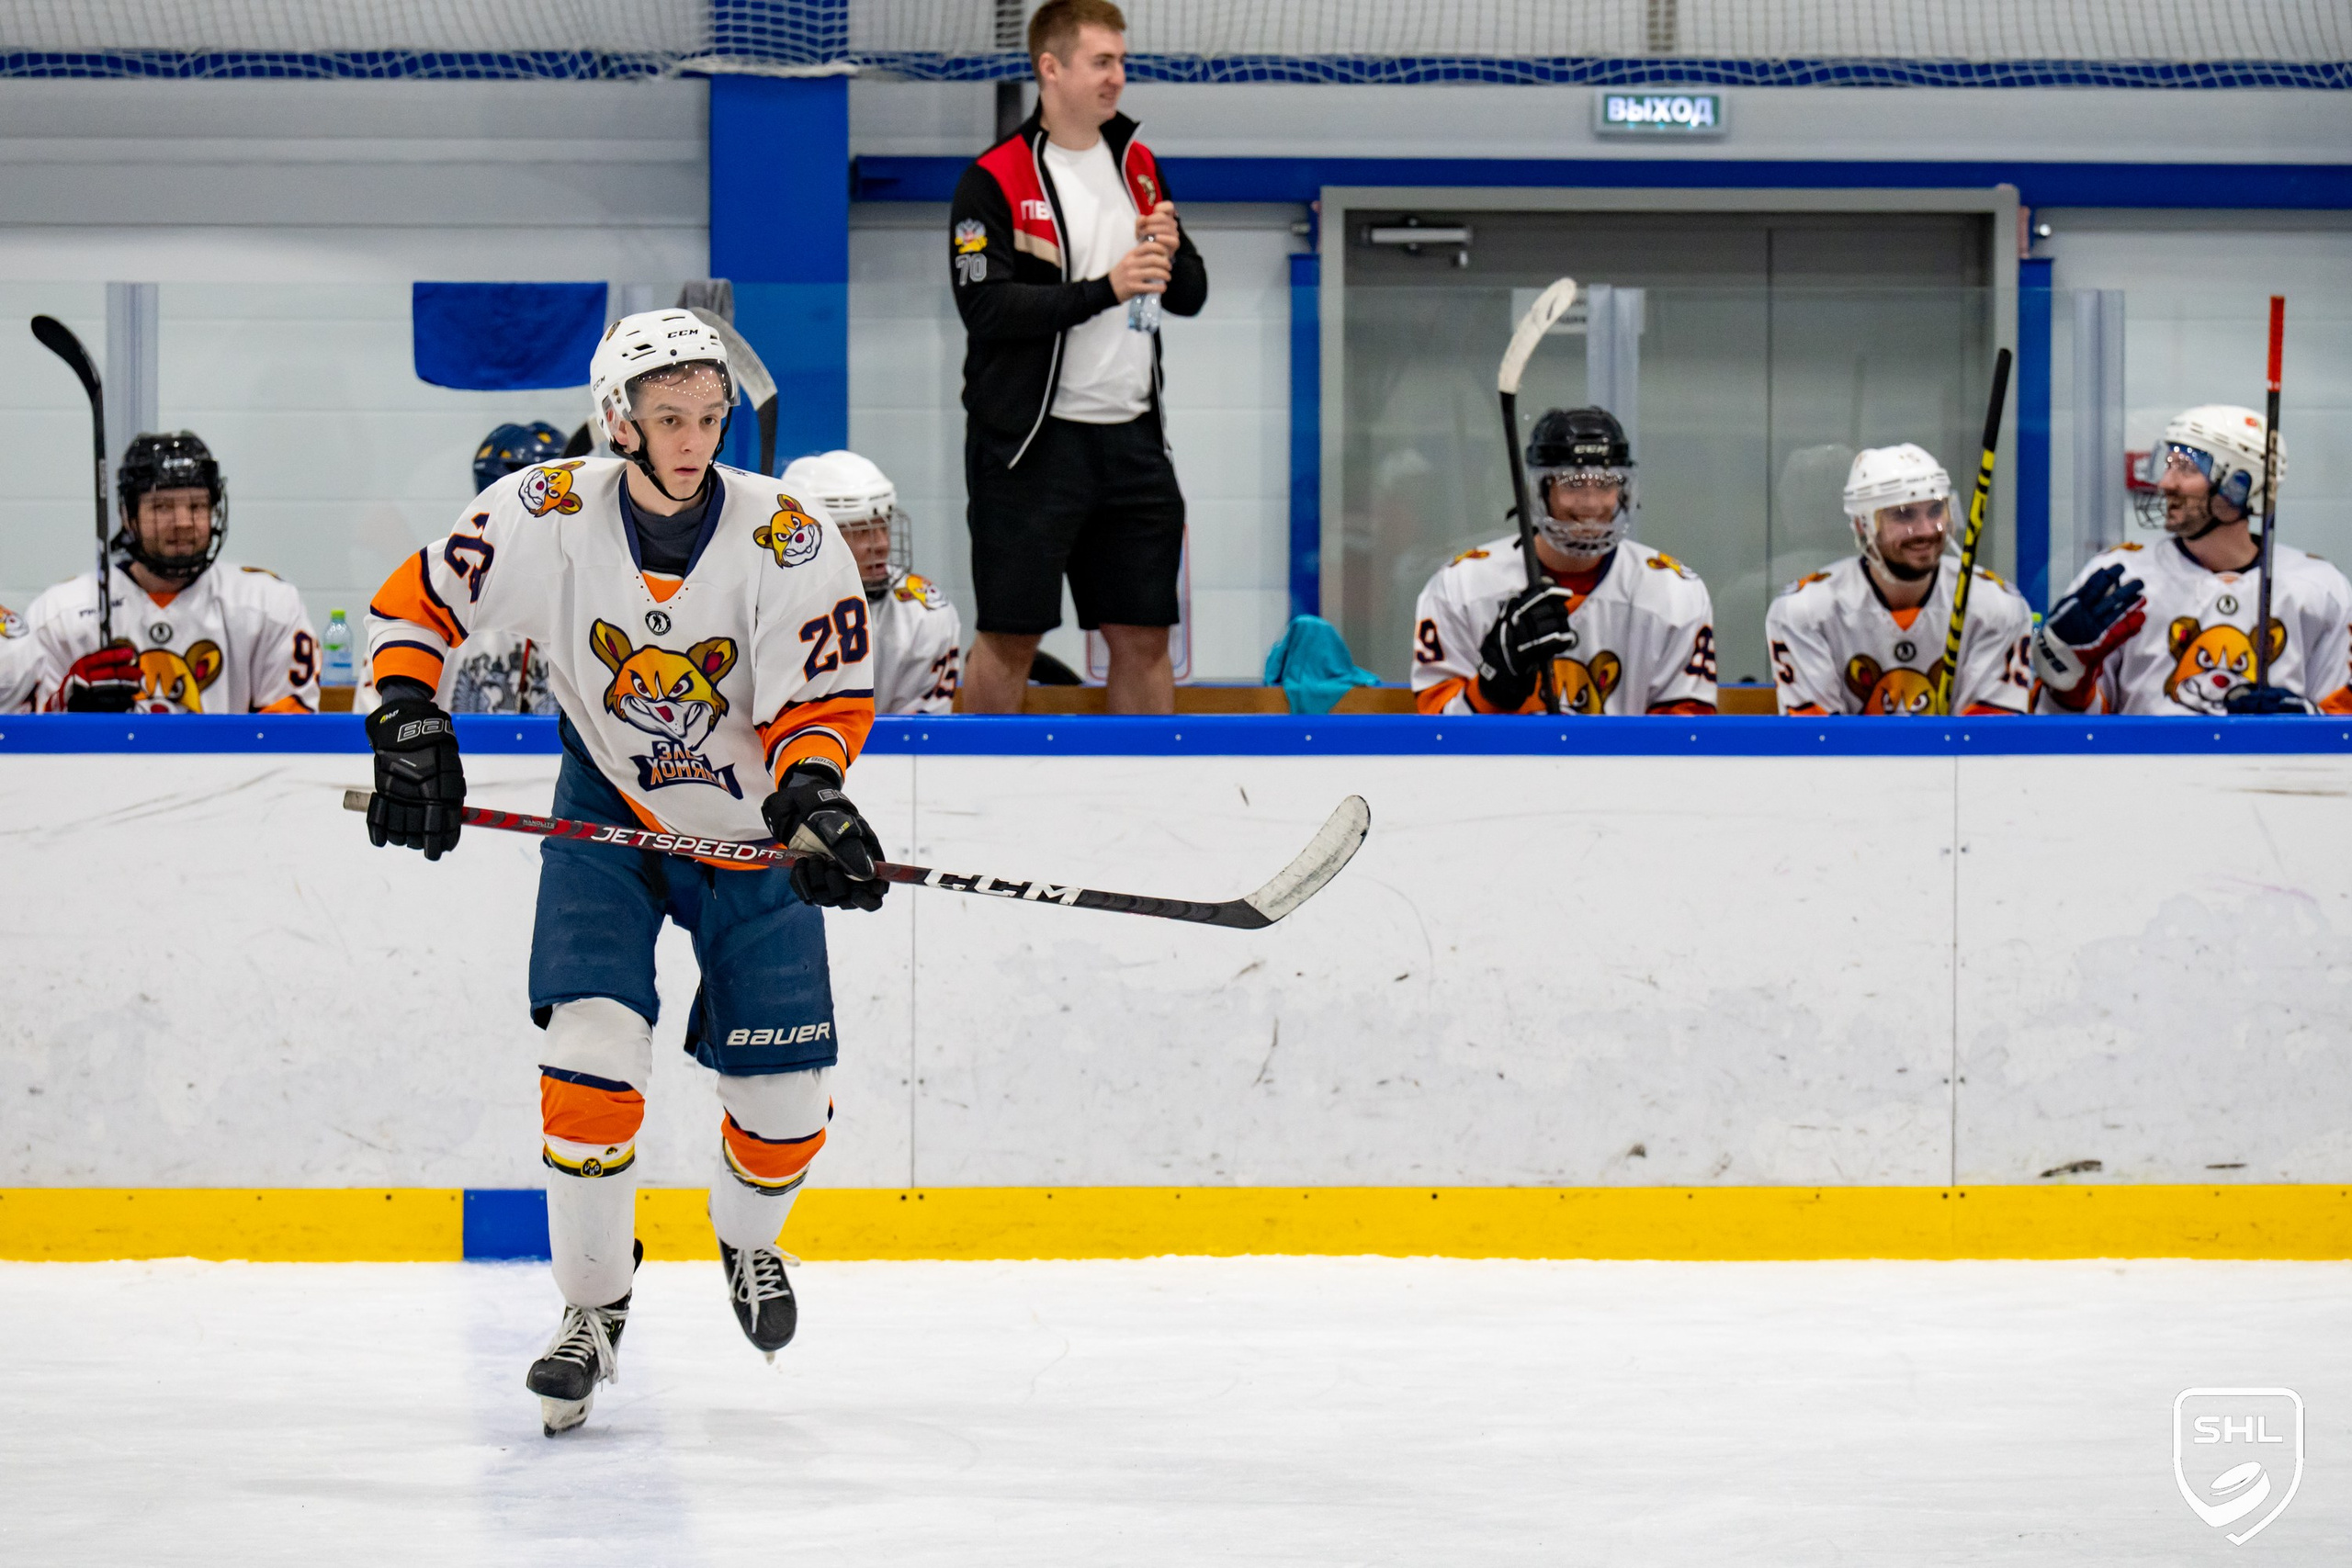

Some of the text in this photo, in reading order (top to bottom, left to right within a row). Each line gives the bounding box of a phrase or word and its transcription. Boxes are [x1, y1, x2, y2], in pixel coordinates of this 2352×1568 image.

[1608, 96, 1714, 127] ВЫХОД
[956, 253, 988, 287] 70
[667, 329, 699, 339] CCM
[798, 595, 870, 682] 28
[591, 827, 758, 861] JETSPEED
[923, 868, 1084, 907] CCM
